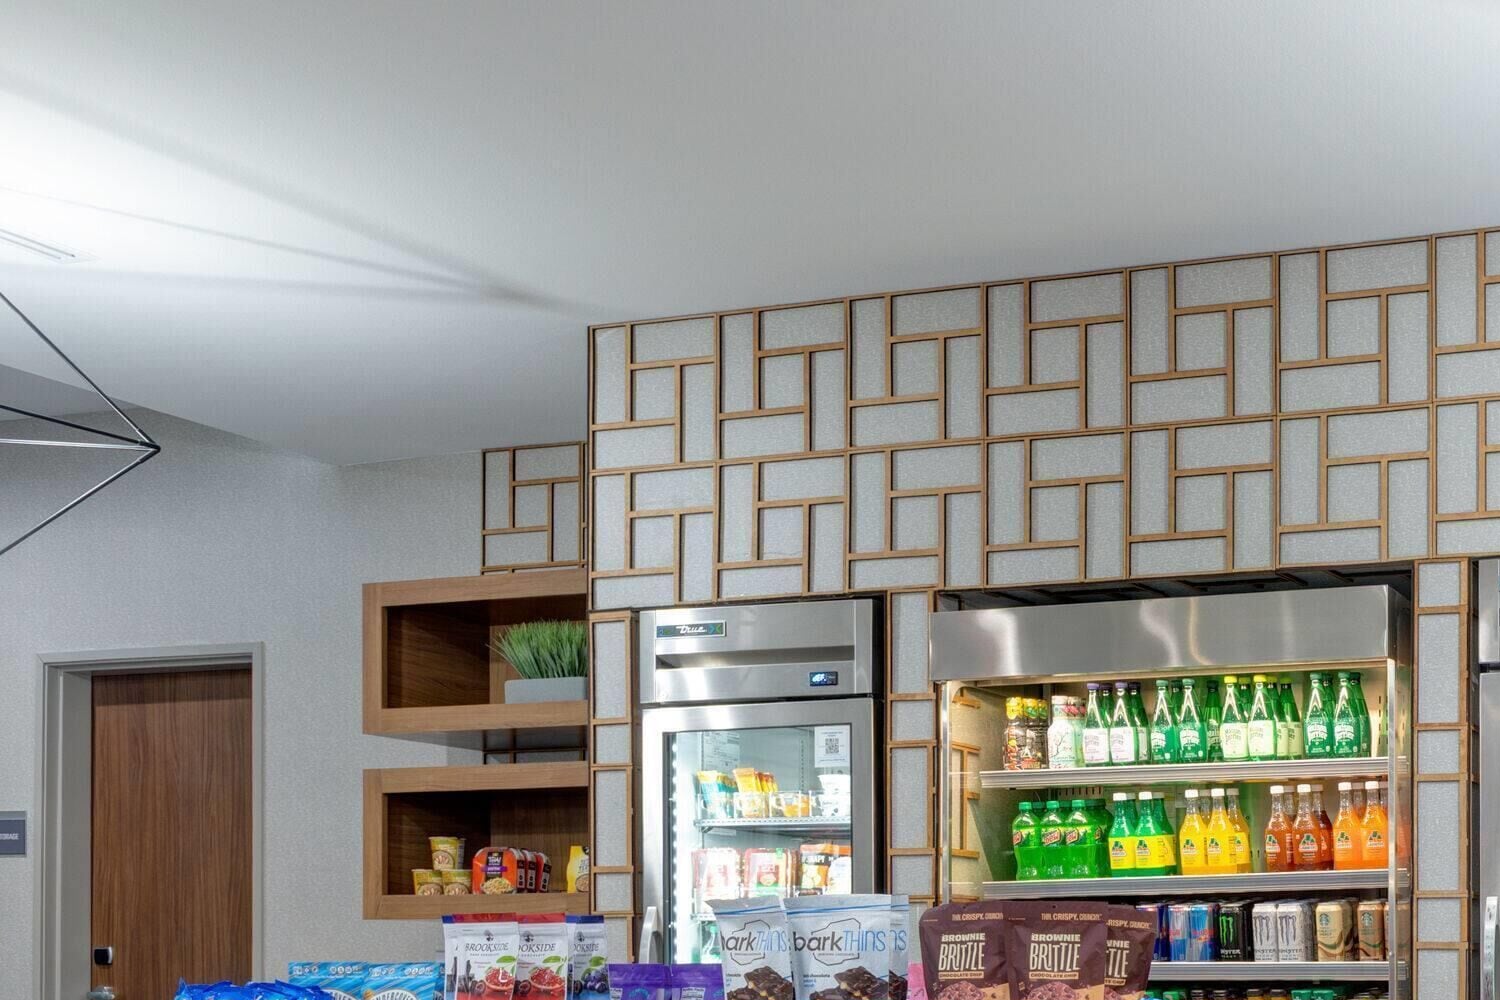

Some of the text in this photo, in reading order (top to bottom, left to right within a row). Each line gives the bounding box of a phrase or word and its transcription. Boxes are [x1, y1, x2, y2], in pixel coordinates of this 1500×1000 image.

[941, 933, 985, 943] BROWNIE
[1031, 933, 1081, 942] BROWNIE
[465, 943, 508, 953] BROOKSIDE
[938, 942, 985, 972] BRITTLE
[1029, 943, 1081, 972] BRITTLE
